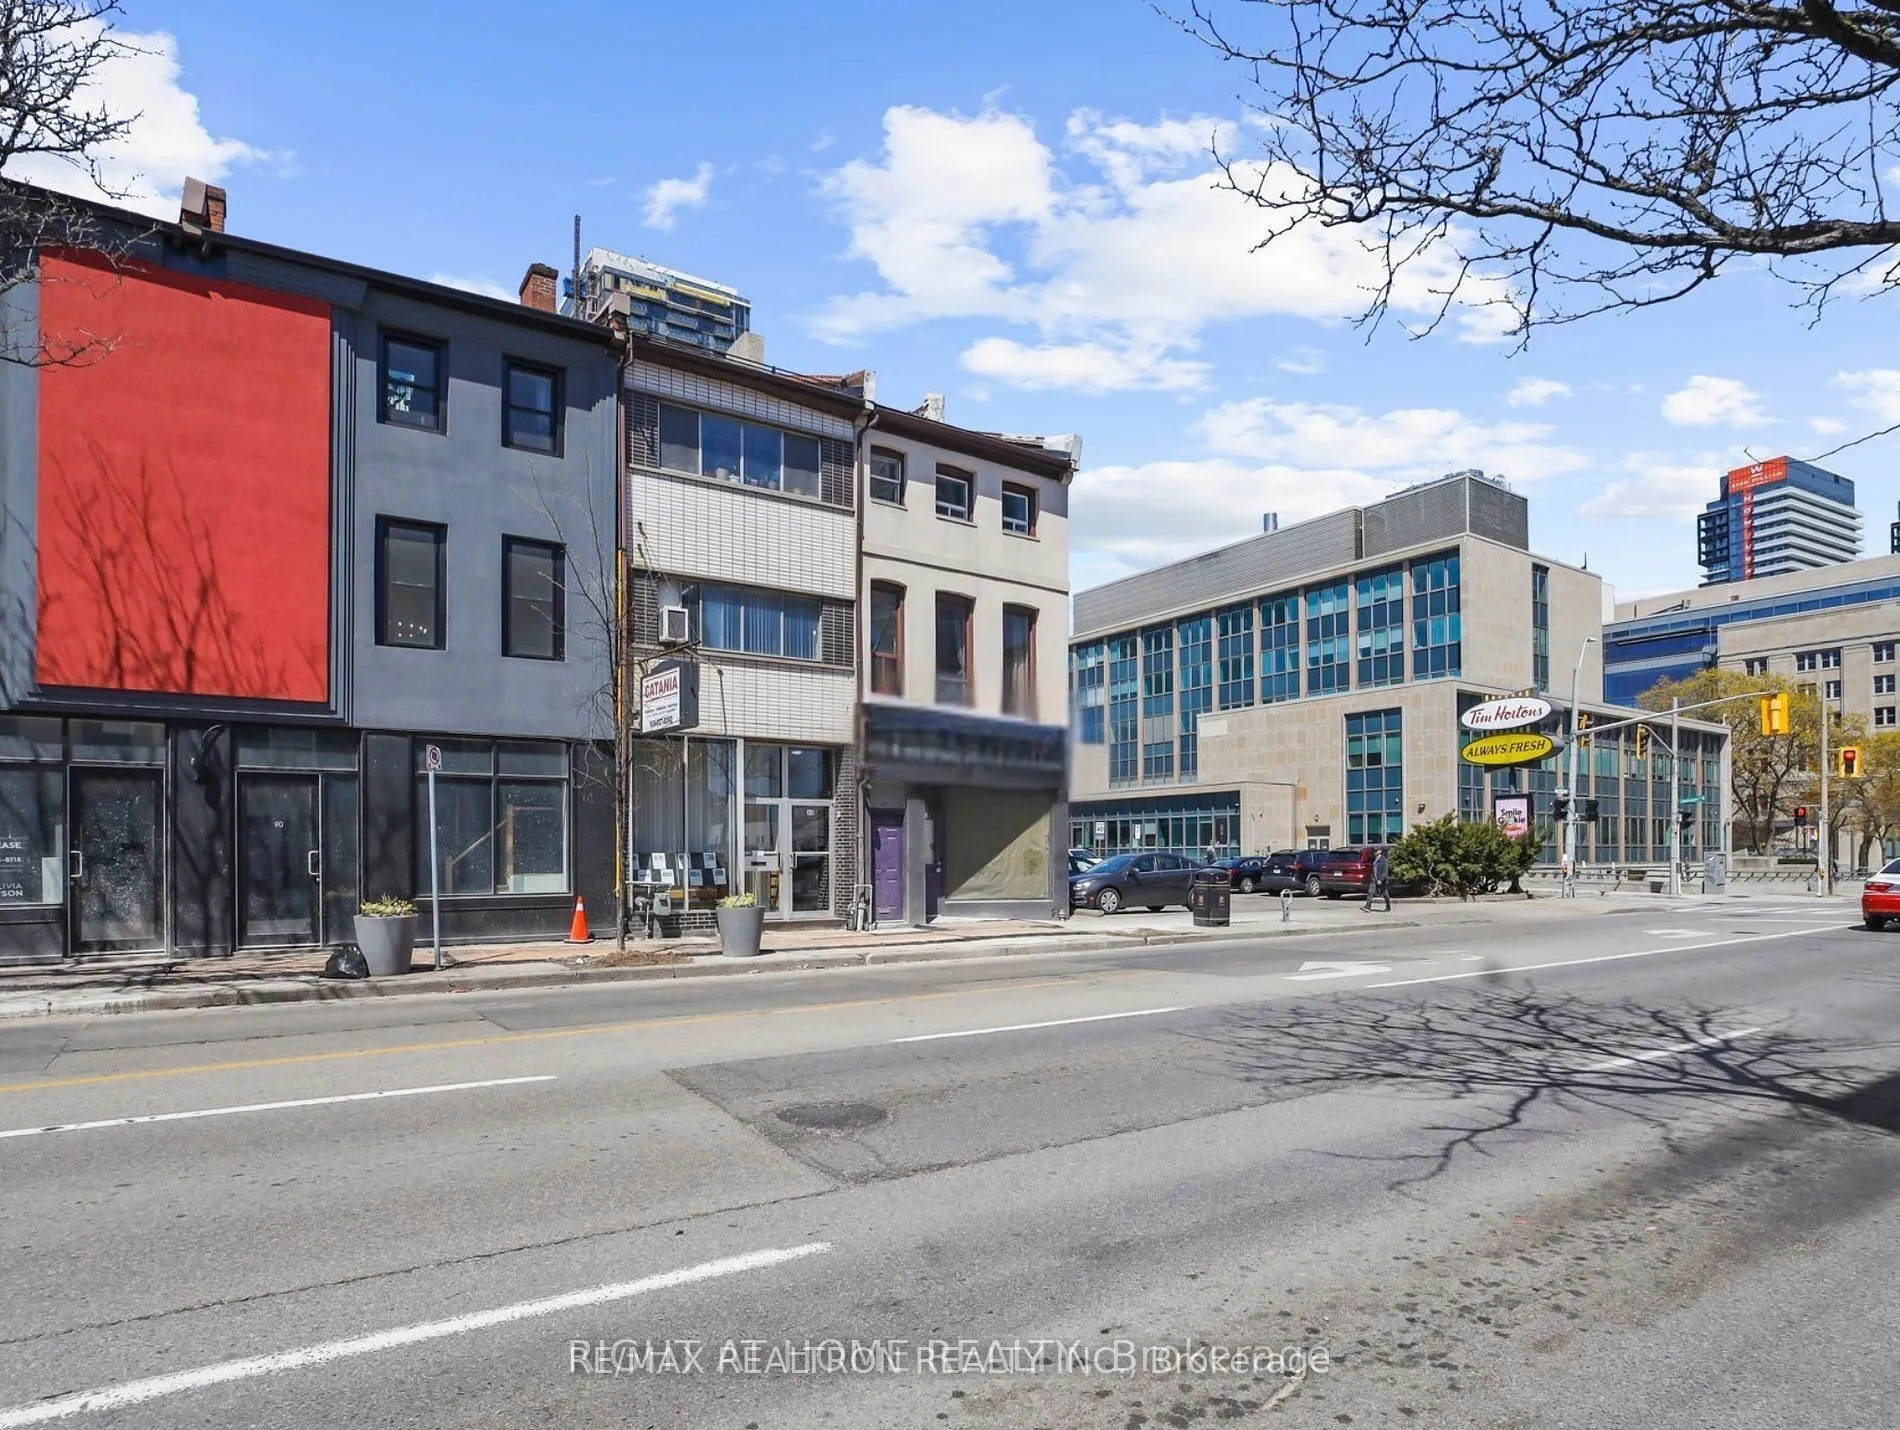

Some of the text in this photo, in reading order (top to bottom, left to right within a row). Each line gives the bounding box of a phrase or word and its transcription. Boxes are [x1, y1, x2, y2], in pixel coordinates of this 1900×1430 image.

[645, 676, 678, 698] CATANIA
[1470, 705, 1543, 725] Tim Hortons
[1466, 740, 1546, 757] ALWAYS FRESH
[1500, 808, 1523, 816] Smile
